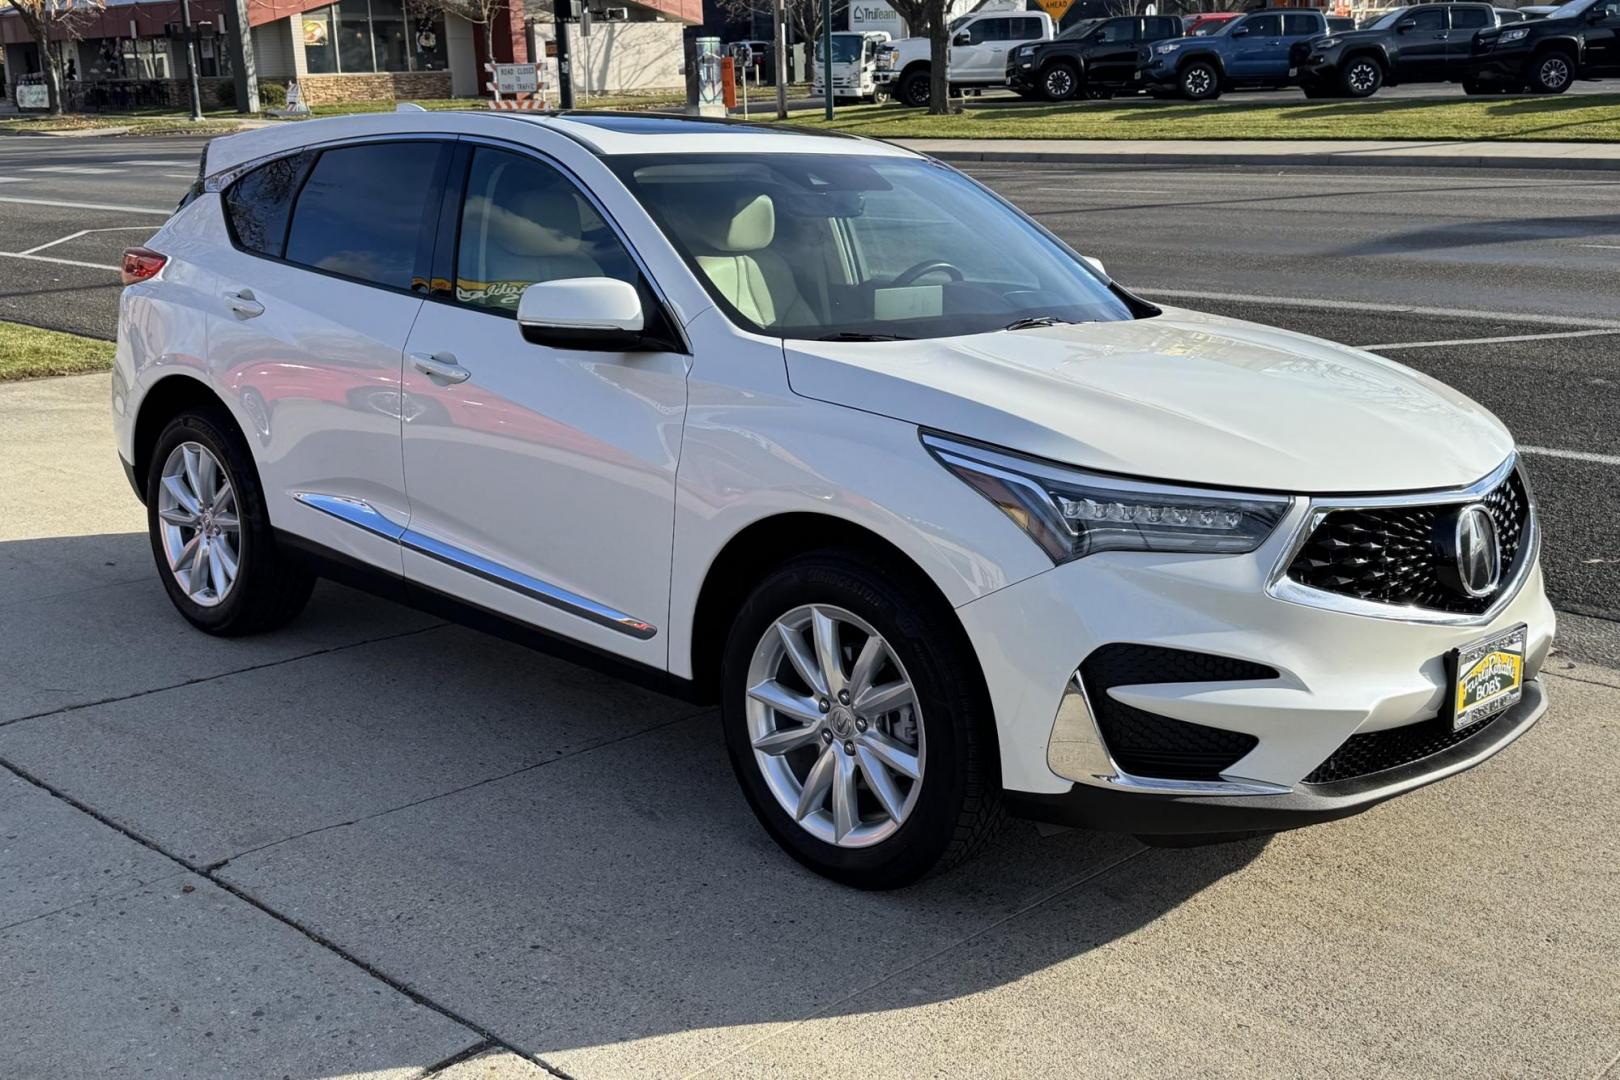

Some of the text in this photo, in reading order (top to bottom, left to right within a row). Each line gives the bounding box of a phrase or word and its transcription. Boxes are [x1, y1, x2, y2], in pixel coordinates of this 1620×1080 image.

[1046, 1, 1067, 9] AHEAD
[864, 8, 897, 20] TruTeam
[501, 68, 514, 76] ROAD
